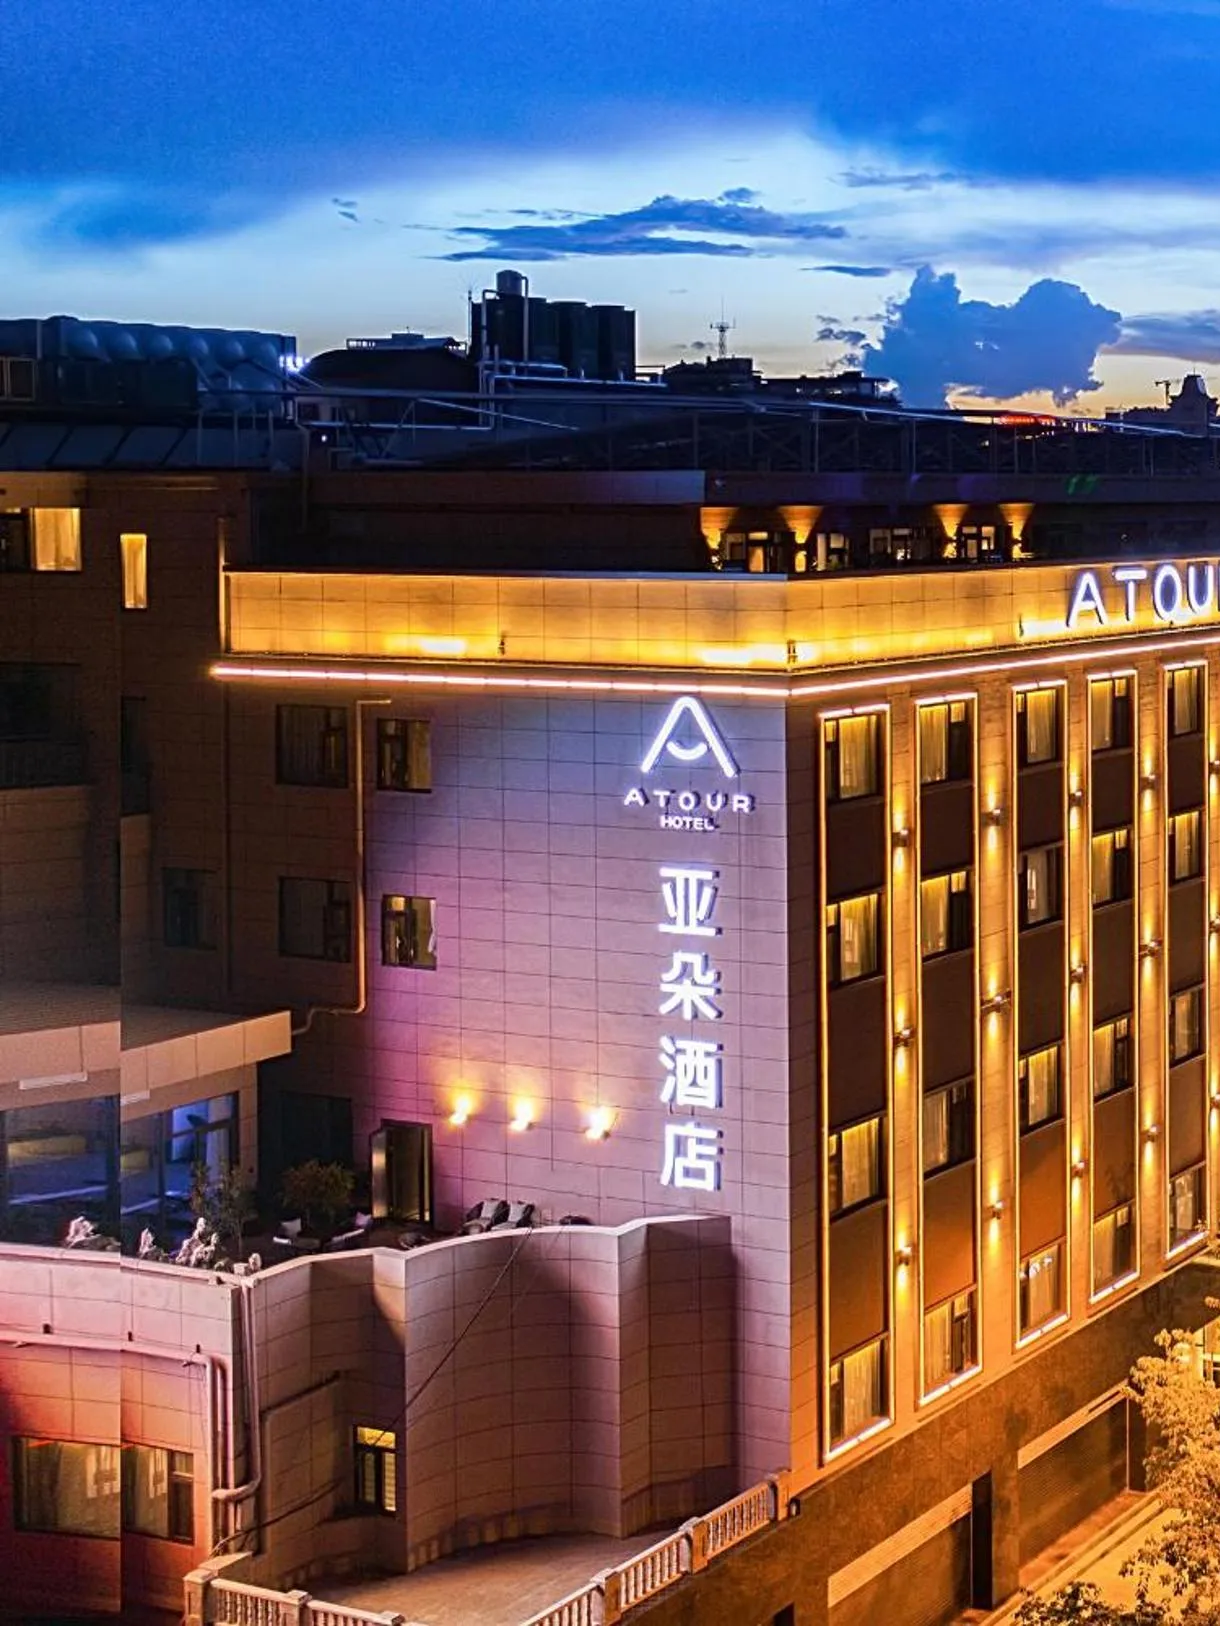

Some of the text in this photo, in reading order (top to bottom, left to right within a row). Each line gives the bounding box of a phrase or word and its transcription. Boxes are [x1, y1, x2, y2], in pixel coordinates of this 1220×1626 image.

[623, 787, 752, 814] ATOUR
[659, 815, 717, 831] HOTEL
[658, 866, 724, 1192] 亚朵酒店
